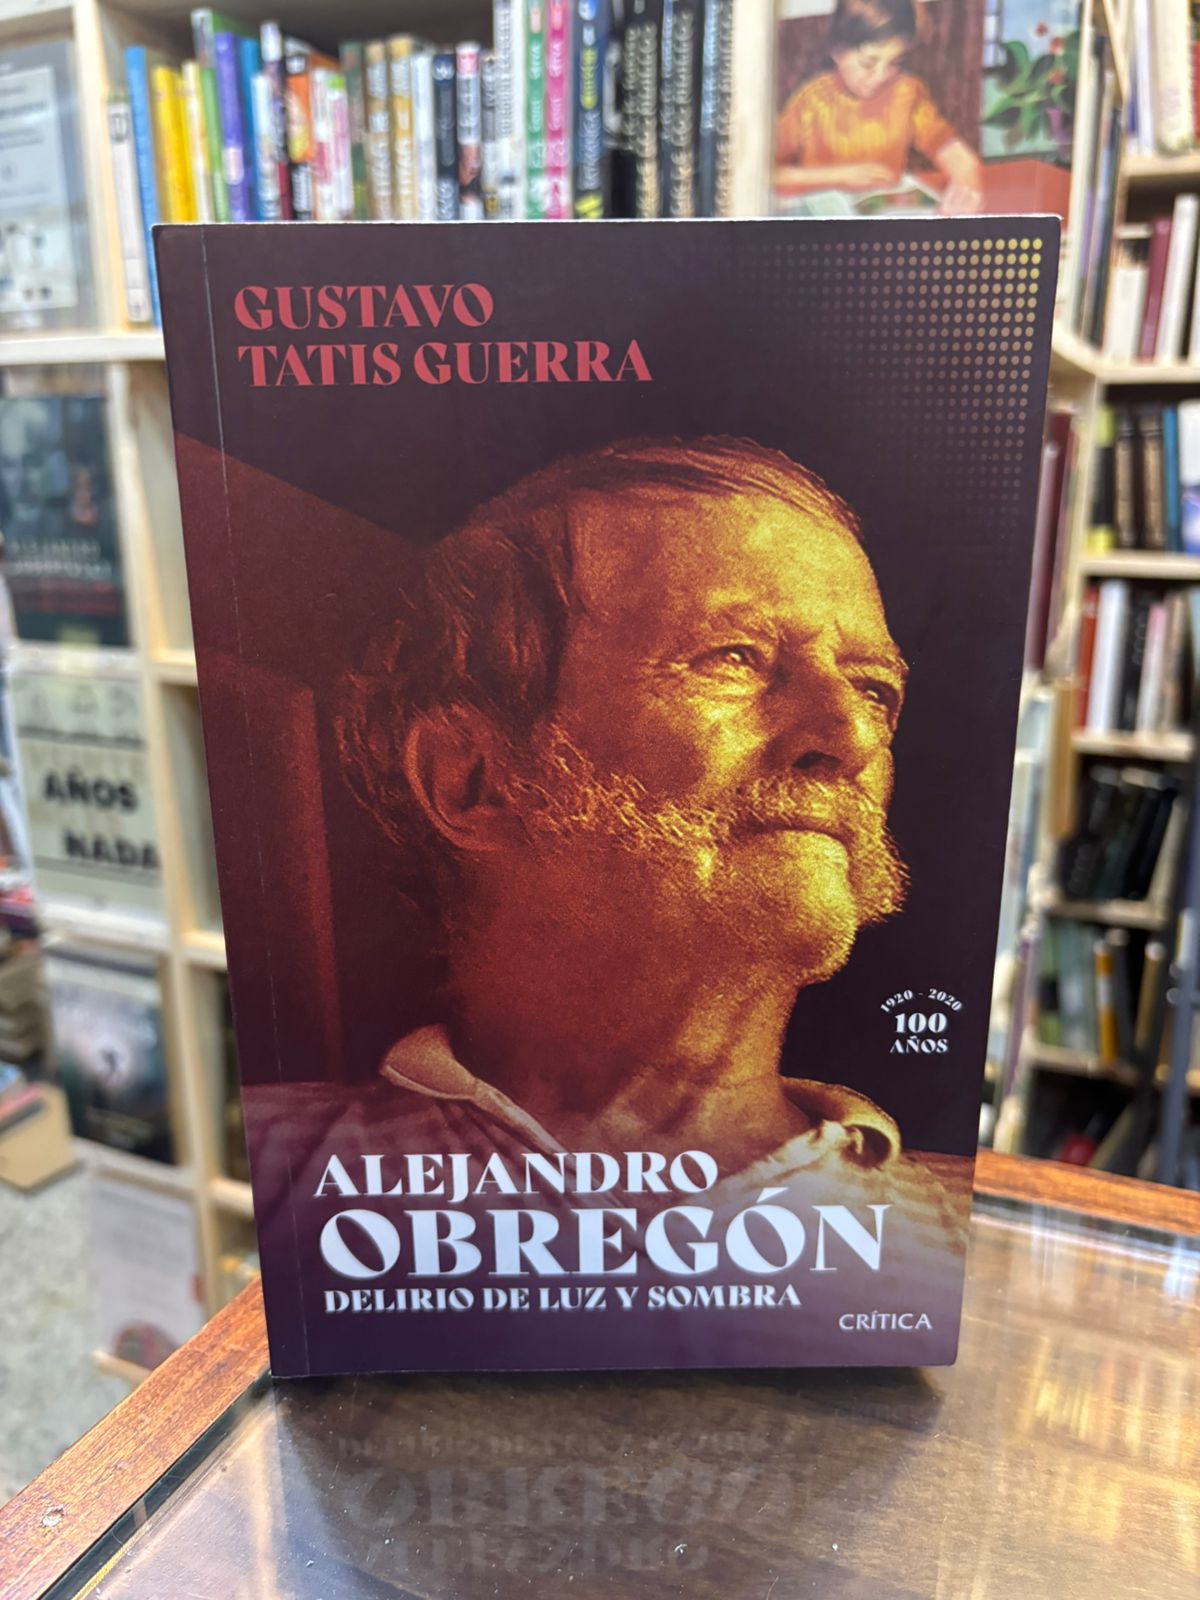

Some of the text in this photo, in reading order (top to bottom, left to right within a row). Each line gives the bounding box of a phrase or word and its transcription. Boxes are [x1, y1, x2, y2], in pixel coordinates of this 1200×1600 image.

[234, 283, 494, 331] GUSTAVO
[238, 339, 653, 388] TATIS GUERRA
[880, 989, 913, 1012] 1920
[928, 988, 962, 1011] 2020
[895, 1012, 947, 1033] 100
[889, 1035, 949, 1054] AÑOS
[313, 1150, 718, 1204] ALEJANDRO
[320, 1187, 892, 1280] OBREGÓN
[323, 1283, 802, 1314] DELIRIO DE LUZ Y SOMBRA
[838, 1309, 933, 1331] CRÍTICA
